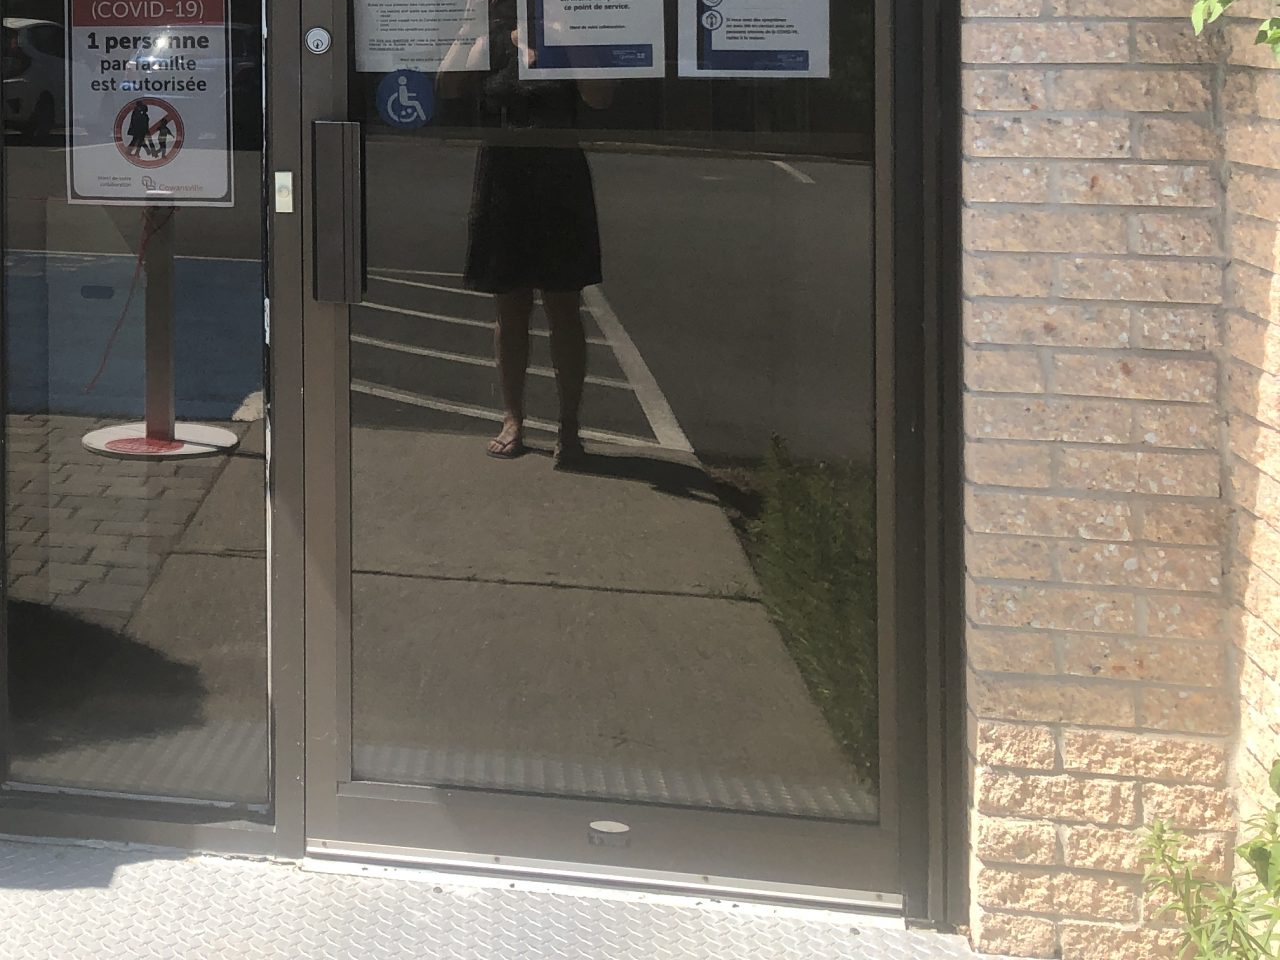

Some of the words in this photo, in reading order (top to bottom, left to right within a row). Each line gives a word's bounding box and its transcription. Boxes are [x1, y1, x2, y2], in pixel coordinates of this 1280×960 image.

[91, 0, 204, 20] (COVID-19)
[574, 3, 592, 11] point
[604, 3, 631, 11] service.
[87, 32, 100, 50] 1
[100, 59, 129, 74] par
[91, 77, 116, 91] est
[121, 76, 207, 91] autorisée
